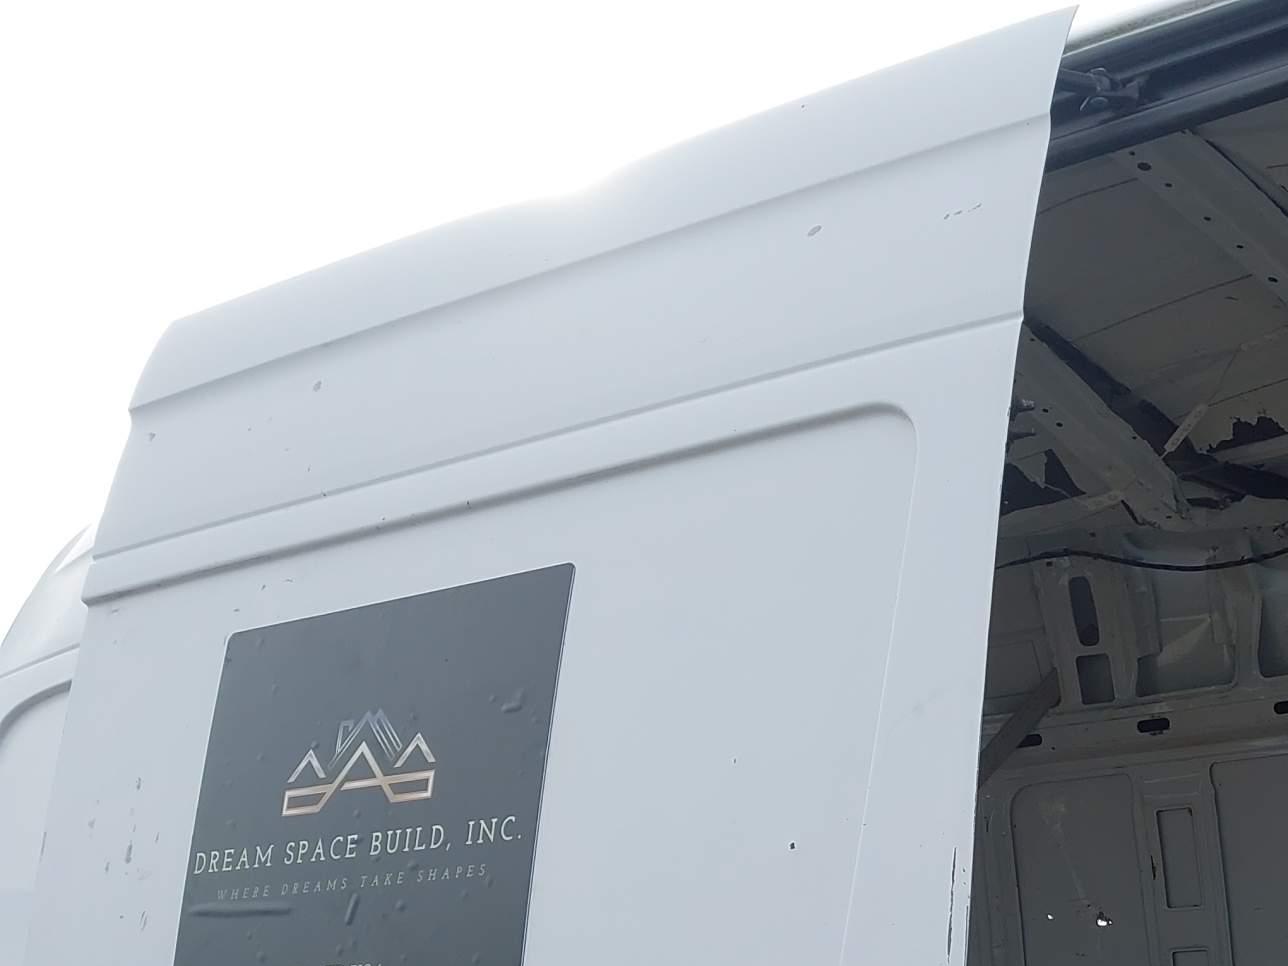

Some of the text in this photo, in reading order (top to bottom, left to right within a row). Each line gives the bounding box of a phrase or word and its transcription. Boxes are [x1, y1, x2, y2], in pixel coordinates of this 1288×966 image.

[193, 815, 522, 875] DREAM SPACE BUILD, INC.
[216, 864, 488, 901] WHERE DREAMS TAKE SHAPES
